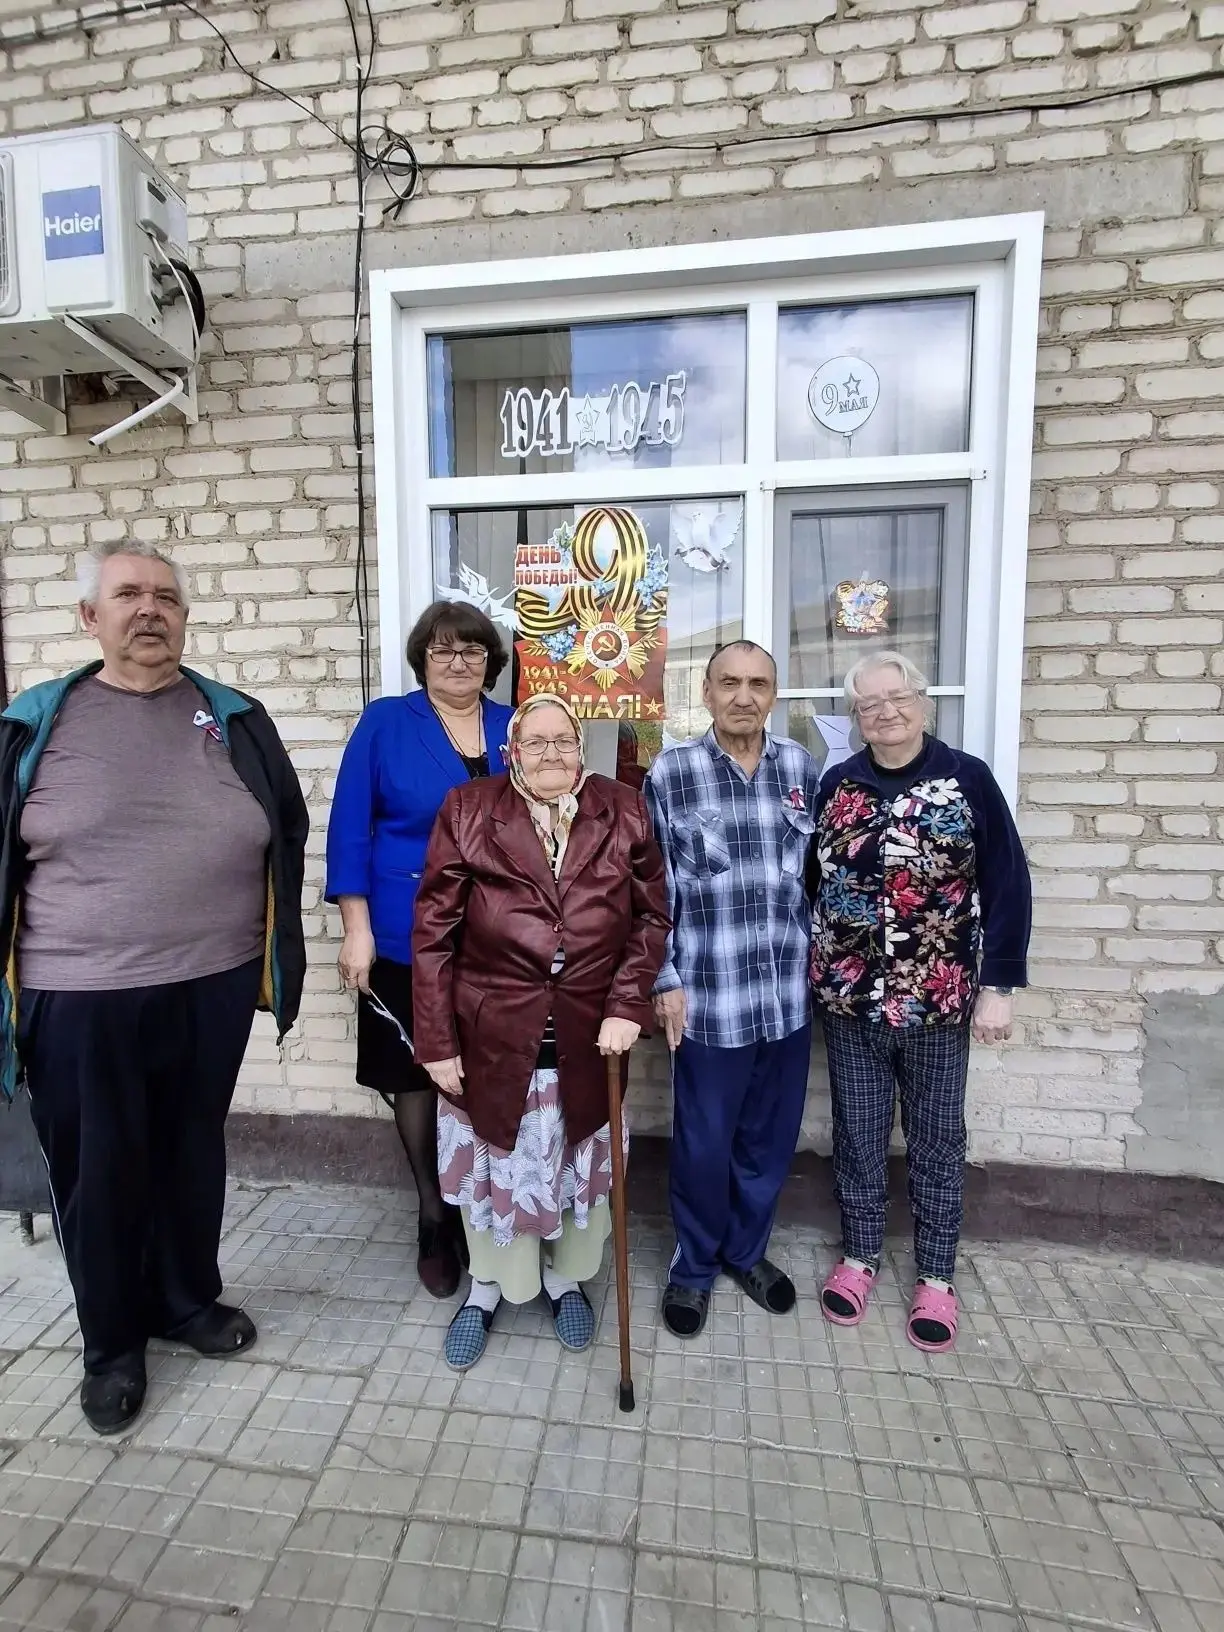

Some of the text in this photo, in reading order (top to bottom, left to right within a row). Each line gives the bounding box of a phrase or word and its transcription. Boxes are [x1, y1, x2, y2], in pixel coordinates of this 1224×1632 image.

[44, 212, 101, 237] Haier
[821, 383, 869, 416] 9 МАЯ
[501, 371, 686, 456] 1941 1945
[516, 546, 562, 567] ДЕНЬ
[515, 568, 578, 587] ПОБЕДЫ!
[523, 666, 567, 680] 1941-
[528, 681, 568, 695] 1945
[570, 694, 641, 719] МАЯ!
